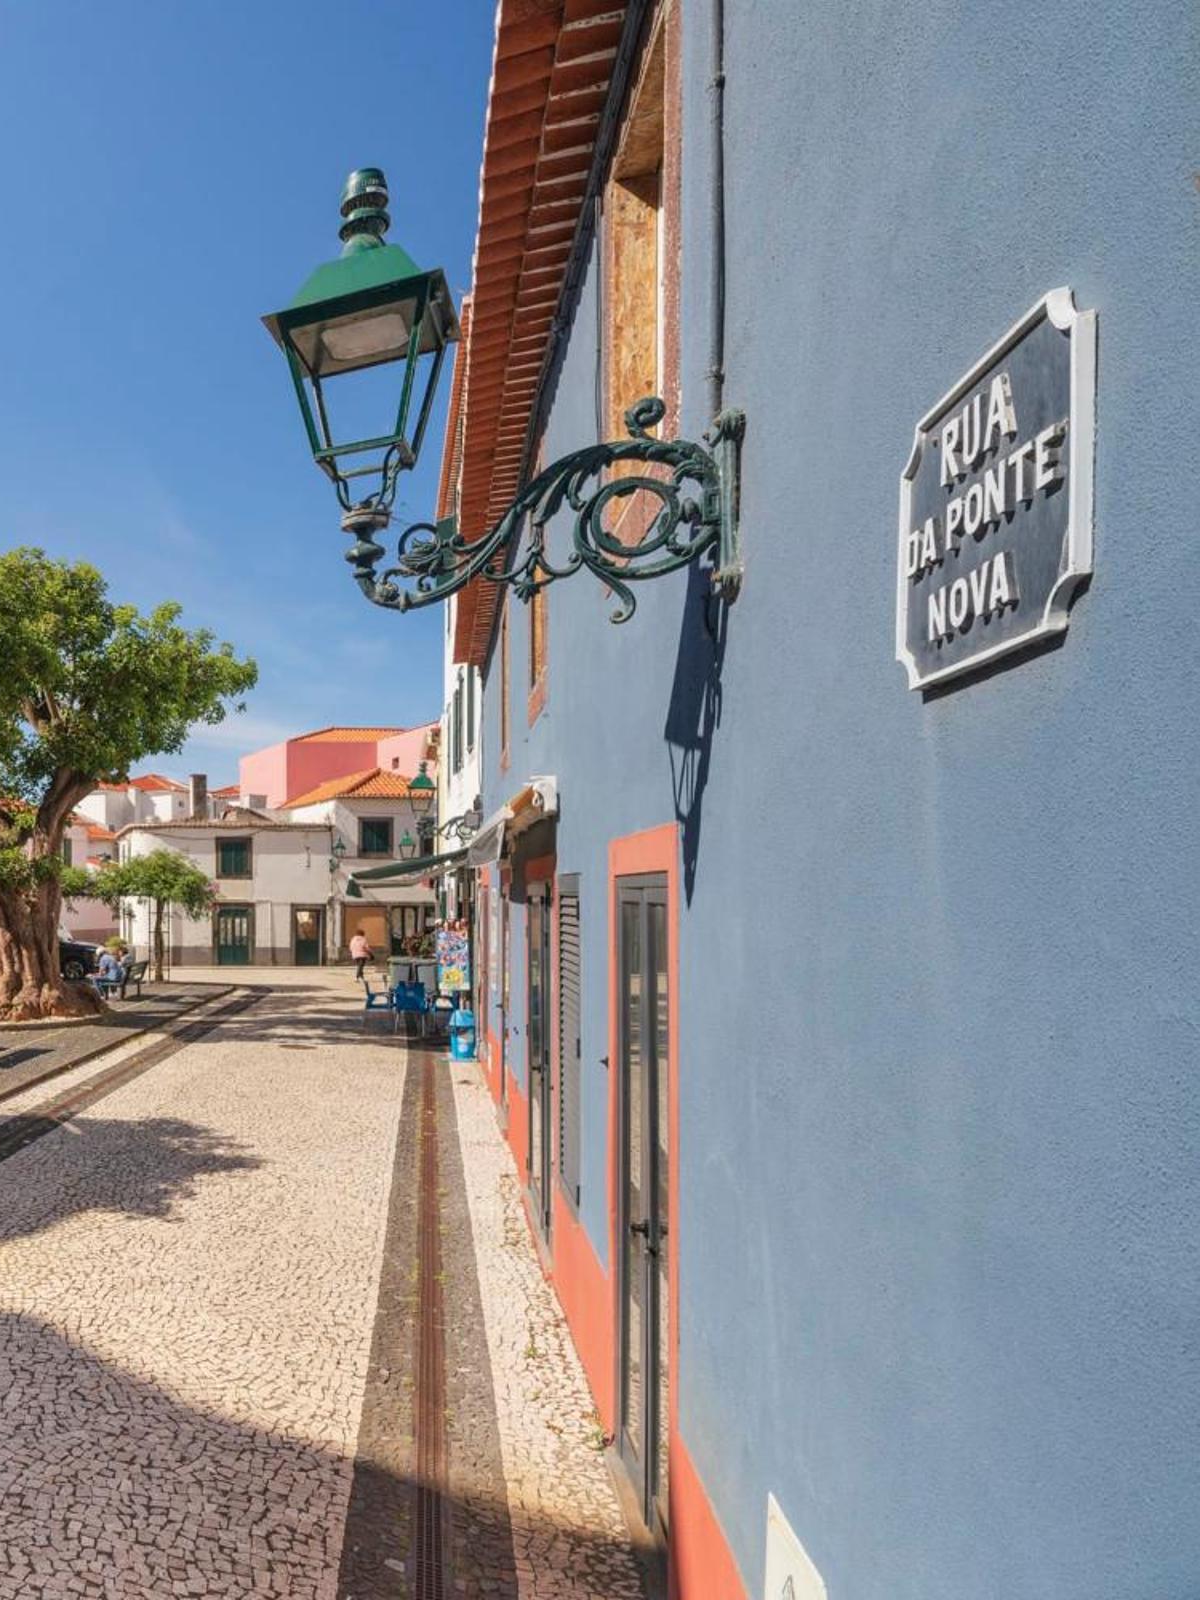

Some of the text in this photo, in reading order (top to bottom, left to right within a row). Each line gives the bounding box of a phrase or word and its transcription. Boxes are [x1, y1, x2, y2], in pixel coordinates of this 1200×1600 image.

[940, 372, 1017, 488] RUA
[906, 422, 1064, 577] DA PONTE
[927, 551, 1011, 641] NOVA
